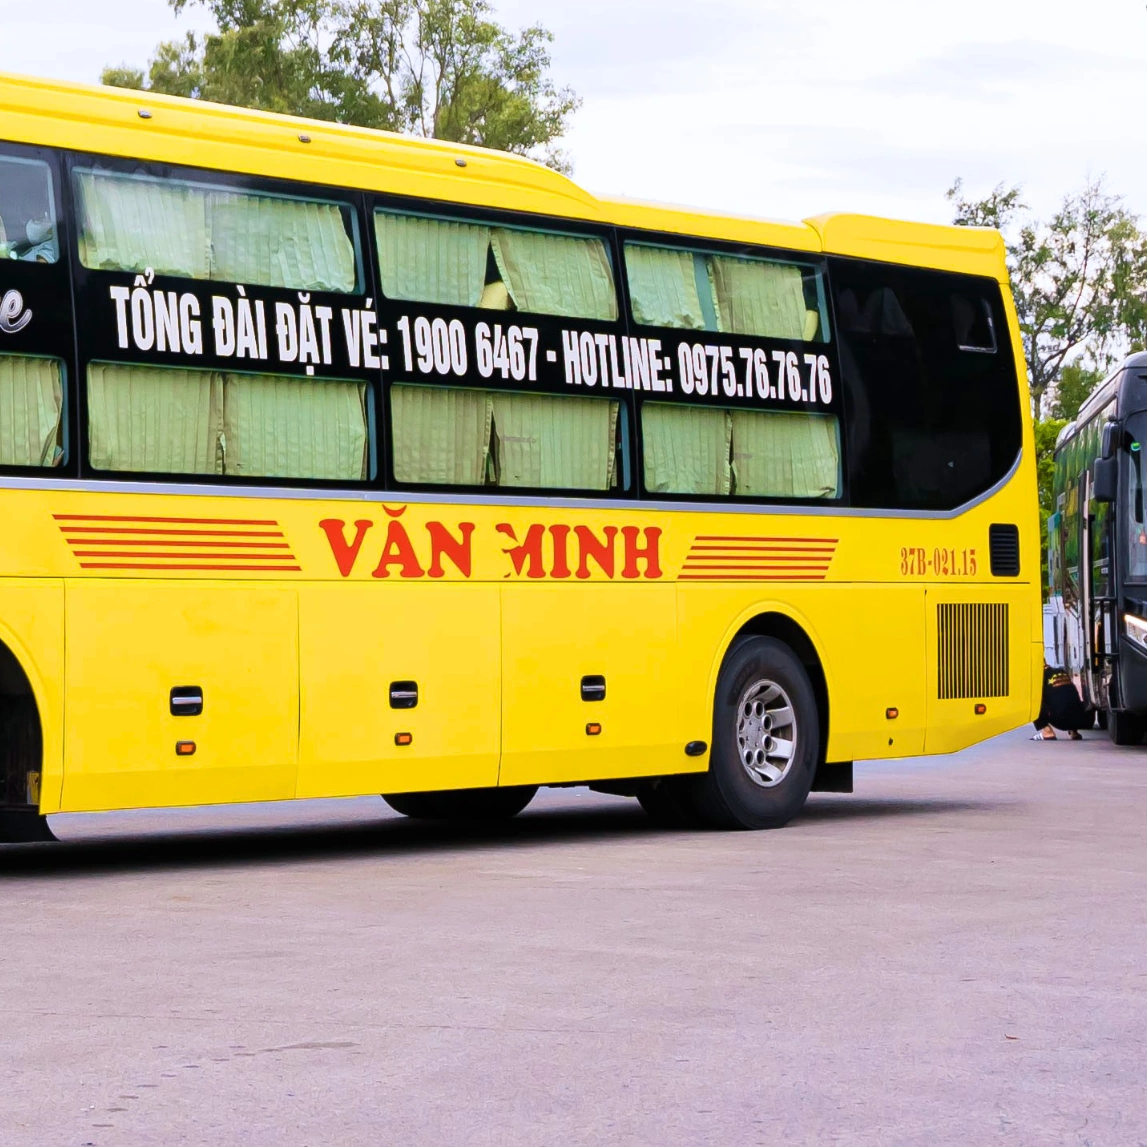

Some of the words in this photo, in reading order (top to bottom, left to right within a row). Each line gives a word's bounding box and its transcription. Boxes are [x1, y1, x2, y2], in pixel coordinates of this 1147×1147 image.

[110, 266, 203, 355] TỔNG
[212, 285, 268, 360] ĐÀI
[275, 292, 333, 376] ĐẶT
[342, 298, 389, 370] VÉ:
[397, 316, 468, 376] 1900
[475, 322, 539, 381] 6467
[562, 330, 673, 392] HOTLINE:
[677, 342, 832, 404] 0975.76.76.76
[319, 504, 475, 578] VĂN
[495, 523, 663, 579] MINH
[900, 547, 977, 576] 37B-021.15
